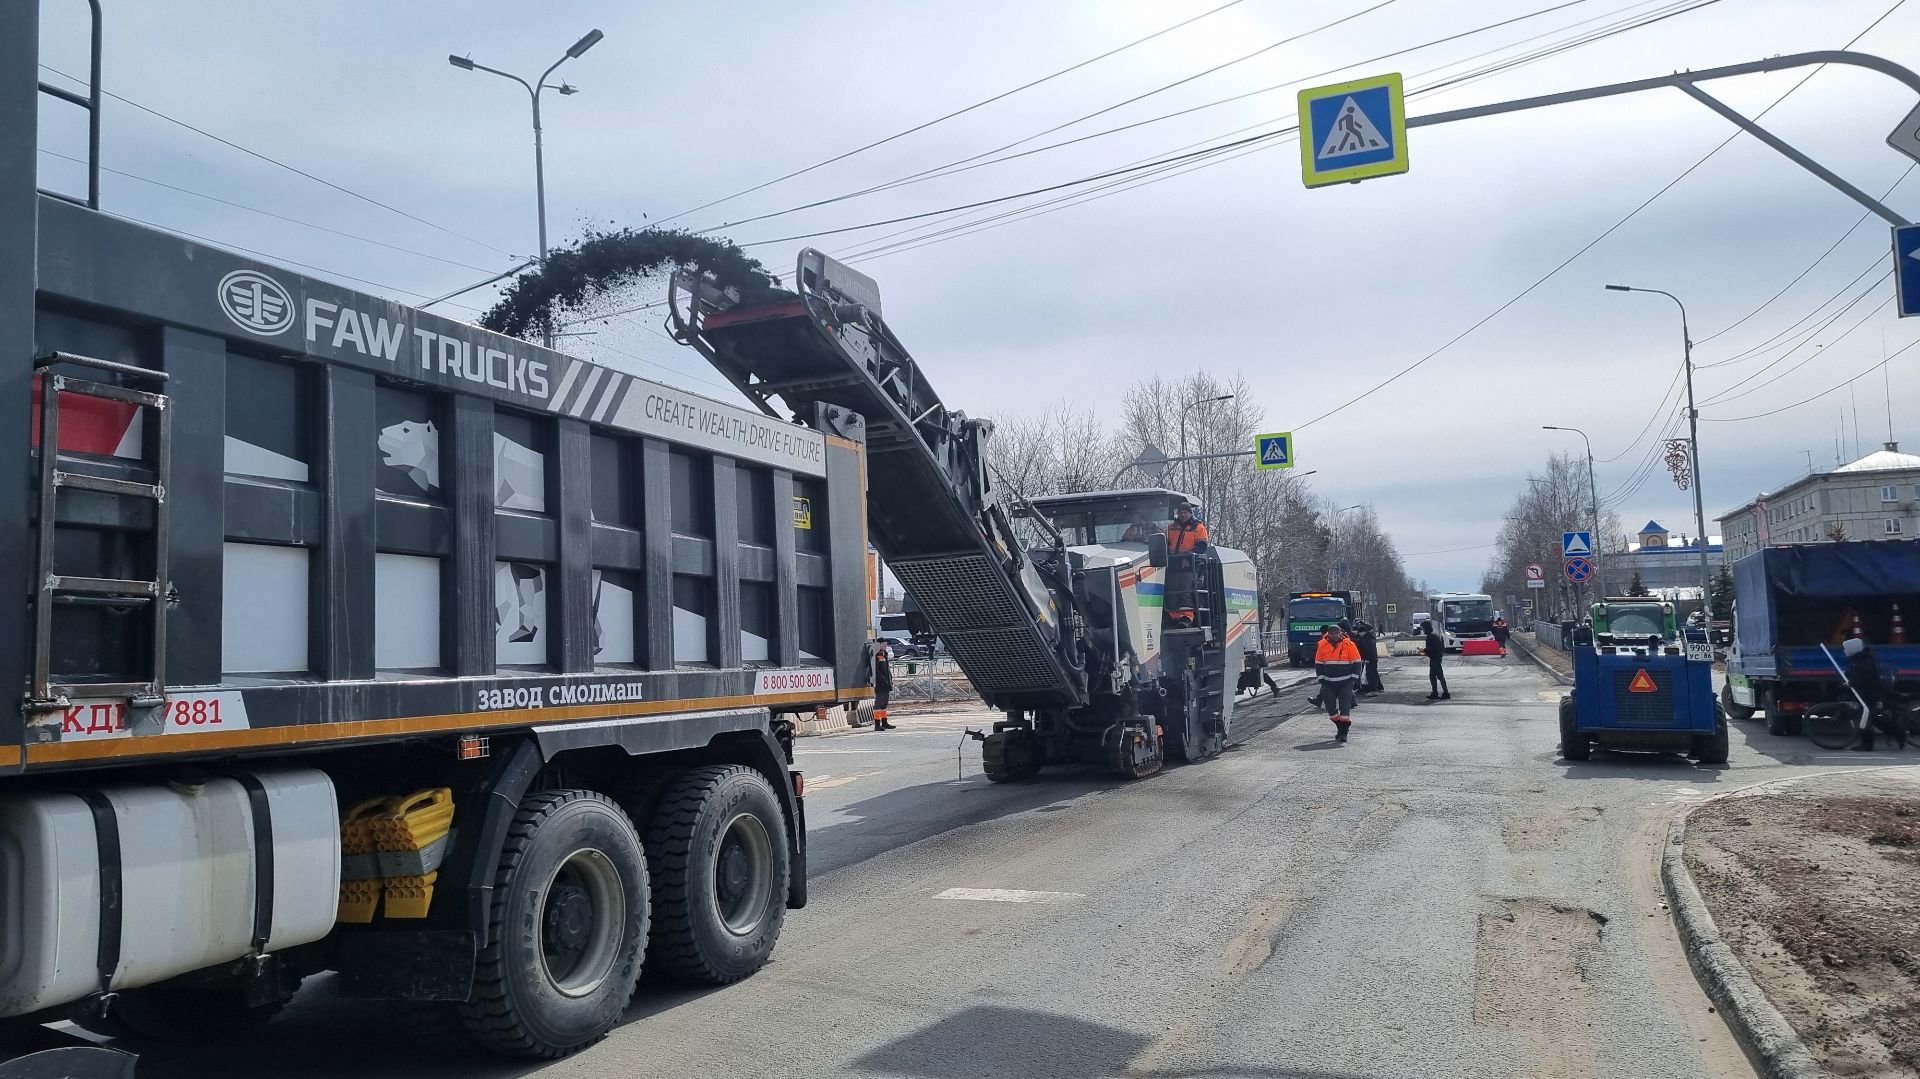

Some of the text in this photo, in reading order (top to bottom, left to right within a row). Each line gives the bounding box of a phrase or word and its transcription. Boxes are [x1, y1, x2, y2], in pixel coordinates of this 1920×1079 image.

[306, 298, 549, 398] FAW TRUCKS
[645, 395, 695, 429] CREATE
[783, 433, 821, 462] FUTURE
[478, 682, 643, 710] завод смолмаш
[763, 673, 829, 689] 8 800 500 800 4
